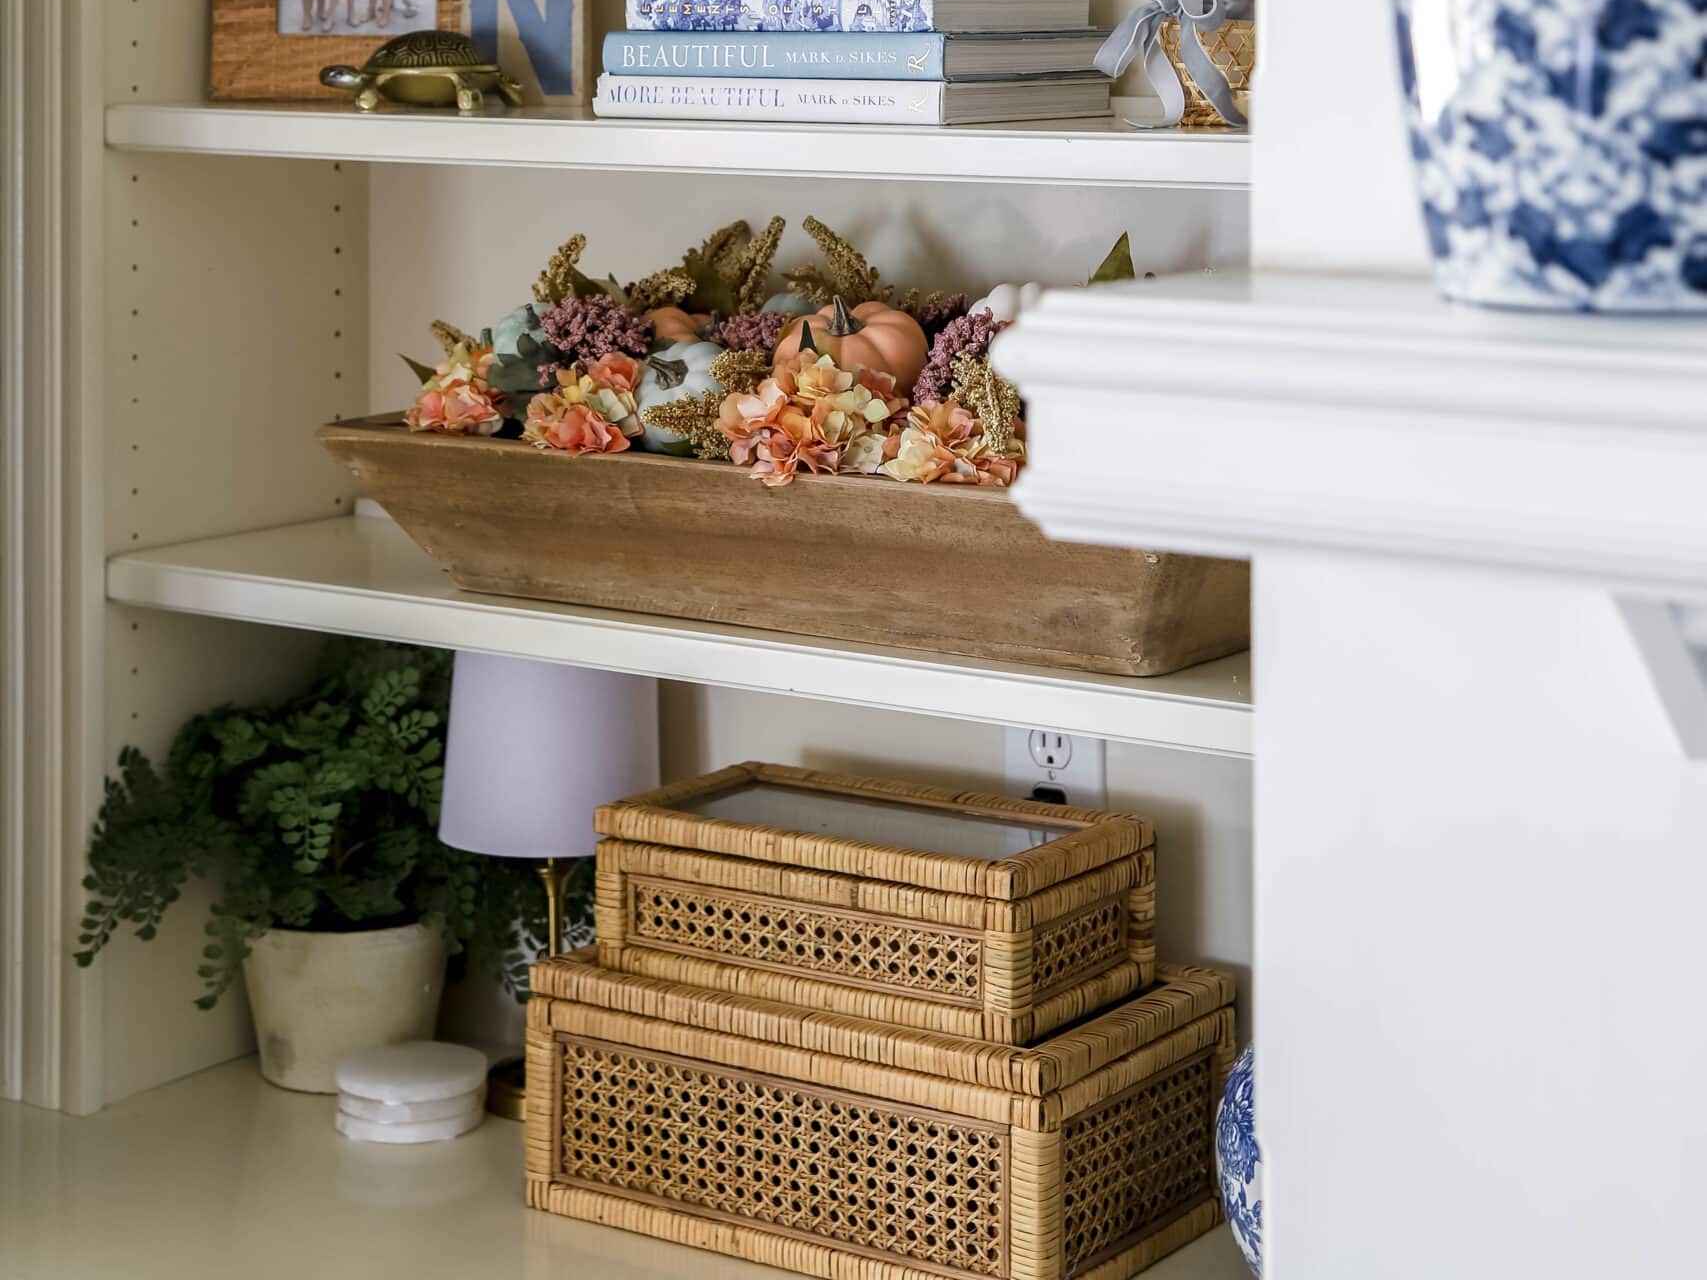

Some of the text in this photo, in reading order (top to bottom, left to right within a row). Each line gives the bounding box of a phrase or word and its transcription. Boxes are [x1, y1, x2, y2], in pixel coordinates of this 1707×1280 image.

[641, 2, 881, 16] ELEMENTS OF STLE
[622, 44, 776, 68] BEAUTIFUL
[785, 51, 831, 64] MARK
[849, 51, 897, 64] SIKES
[608, 85, 664, 104] MORE
[671, 86, 785, 108] BEAUTIFUL
[798, 93, 838, 105] MARK
[852, 95, 896, 107] SIKES
